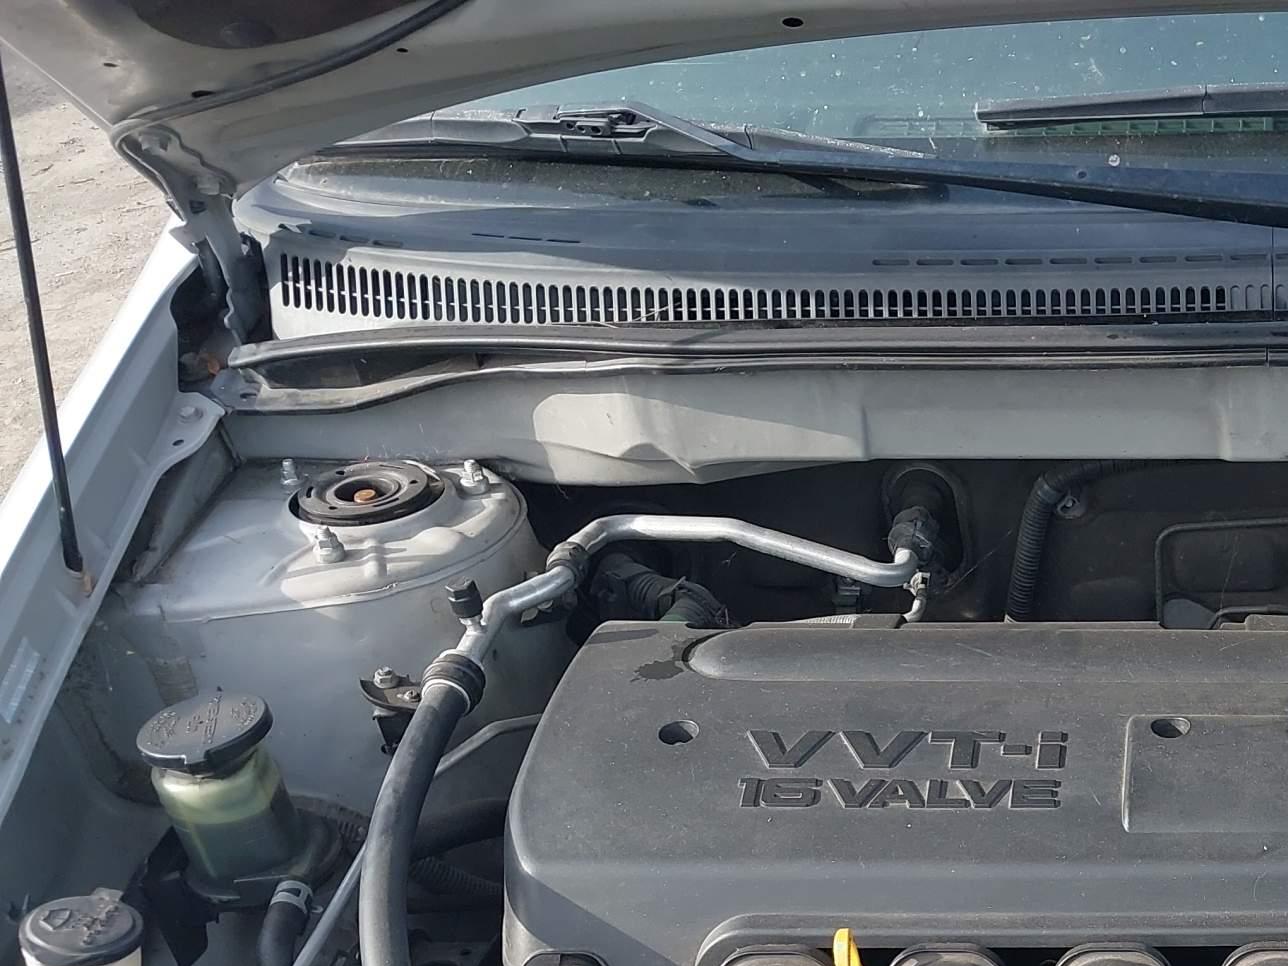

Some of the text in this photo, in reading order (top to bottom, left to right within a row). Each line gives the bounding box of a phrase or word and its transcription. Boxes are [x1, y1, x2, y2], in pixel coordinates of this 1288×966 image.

[746, 730, 1068, 769] VVT-i
[738, 778, 1062, 808] 16 VALVE
